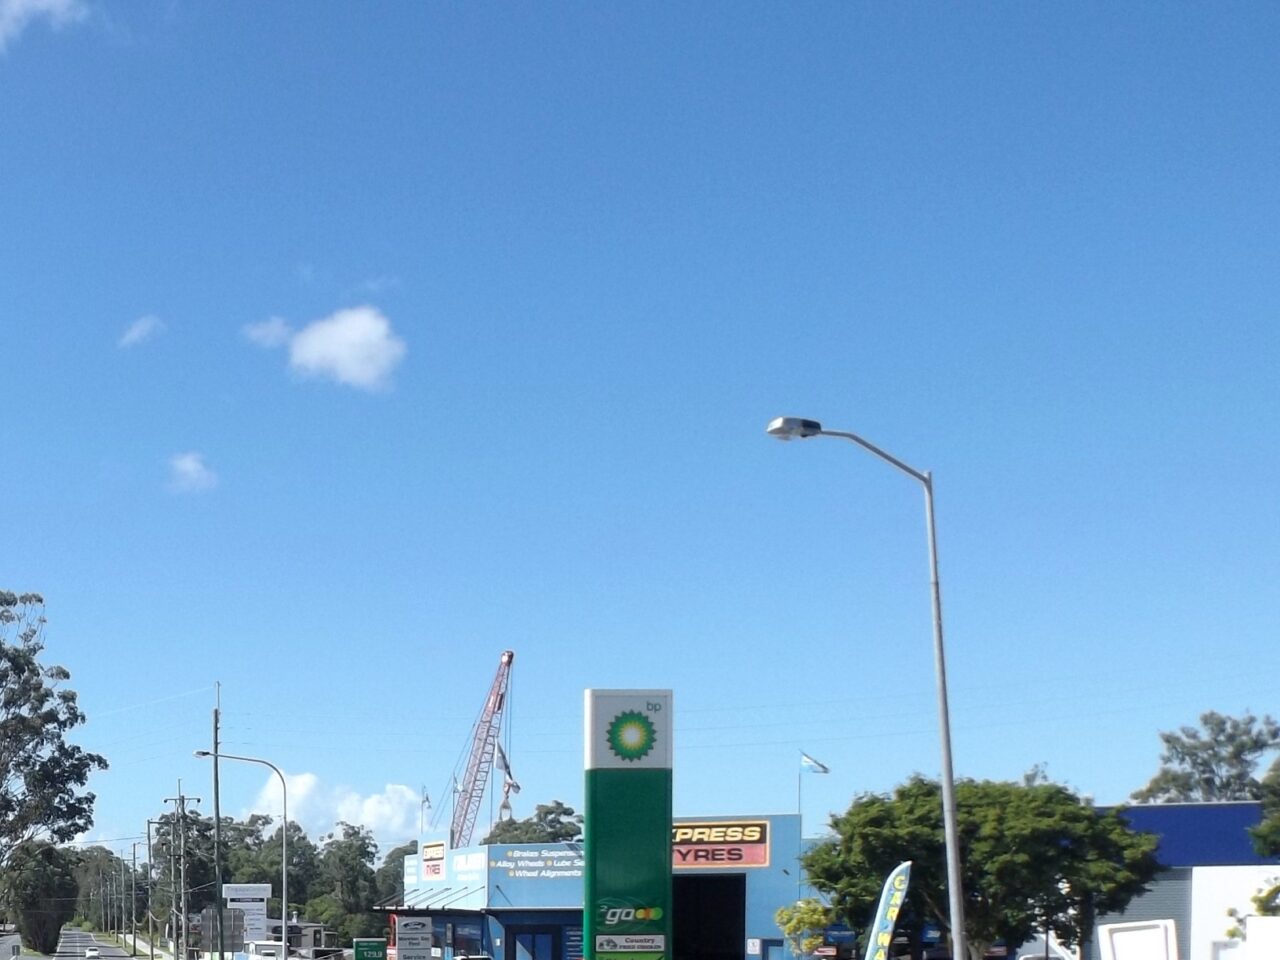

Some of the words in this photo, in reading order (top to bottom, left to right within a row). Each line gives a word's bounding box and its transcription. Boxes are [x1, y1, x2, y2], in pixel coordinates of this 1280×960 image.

[646, 700, 662, 714] bp
[672, 847, 743, 862] YRES
[496, 860, 515, 868] Alloy
[540, 870, 582, 878] Alignments
[887, 875, 906, 921] CAR
